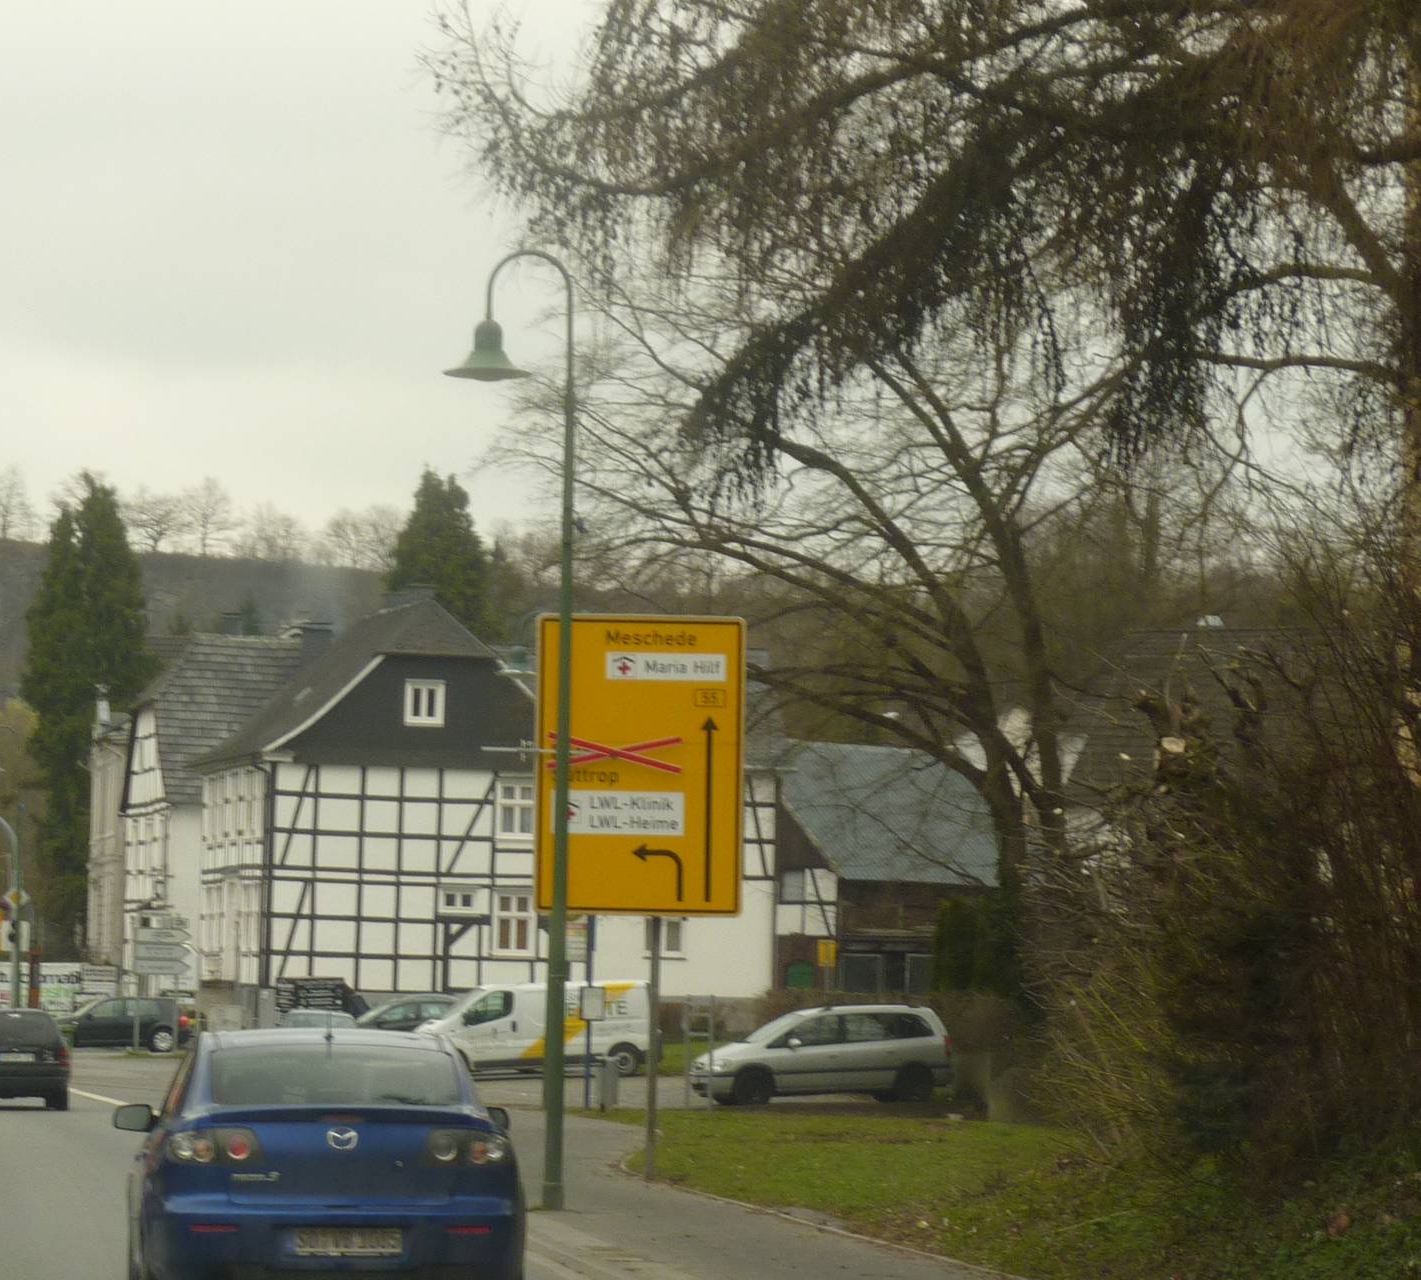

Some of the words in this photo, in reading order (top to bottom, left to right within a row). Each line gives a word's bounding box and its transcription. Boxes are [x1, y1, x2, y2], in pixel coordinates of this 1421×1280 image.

[605, 630, 697, 646] Meschede
[644, 660, 688, 674] Maria
[693, 660, 721, 675] Hilf
[701, 692, 718, 704] 55
[589, 795, 674, 811] LWL-Klinik
[588, 815, 679, 830] LWL-Heime
